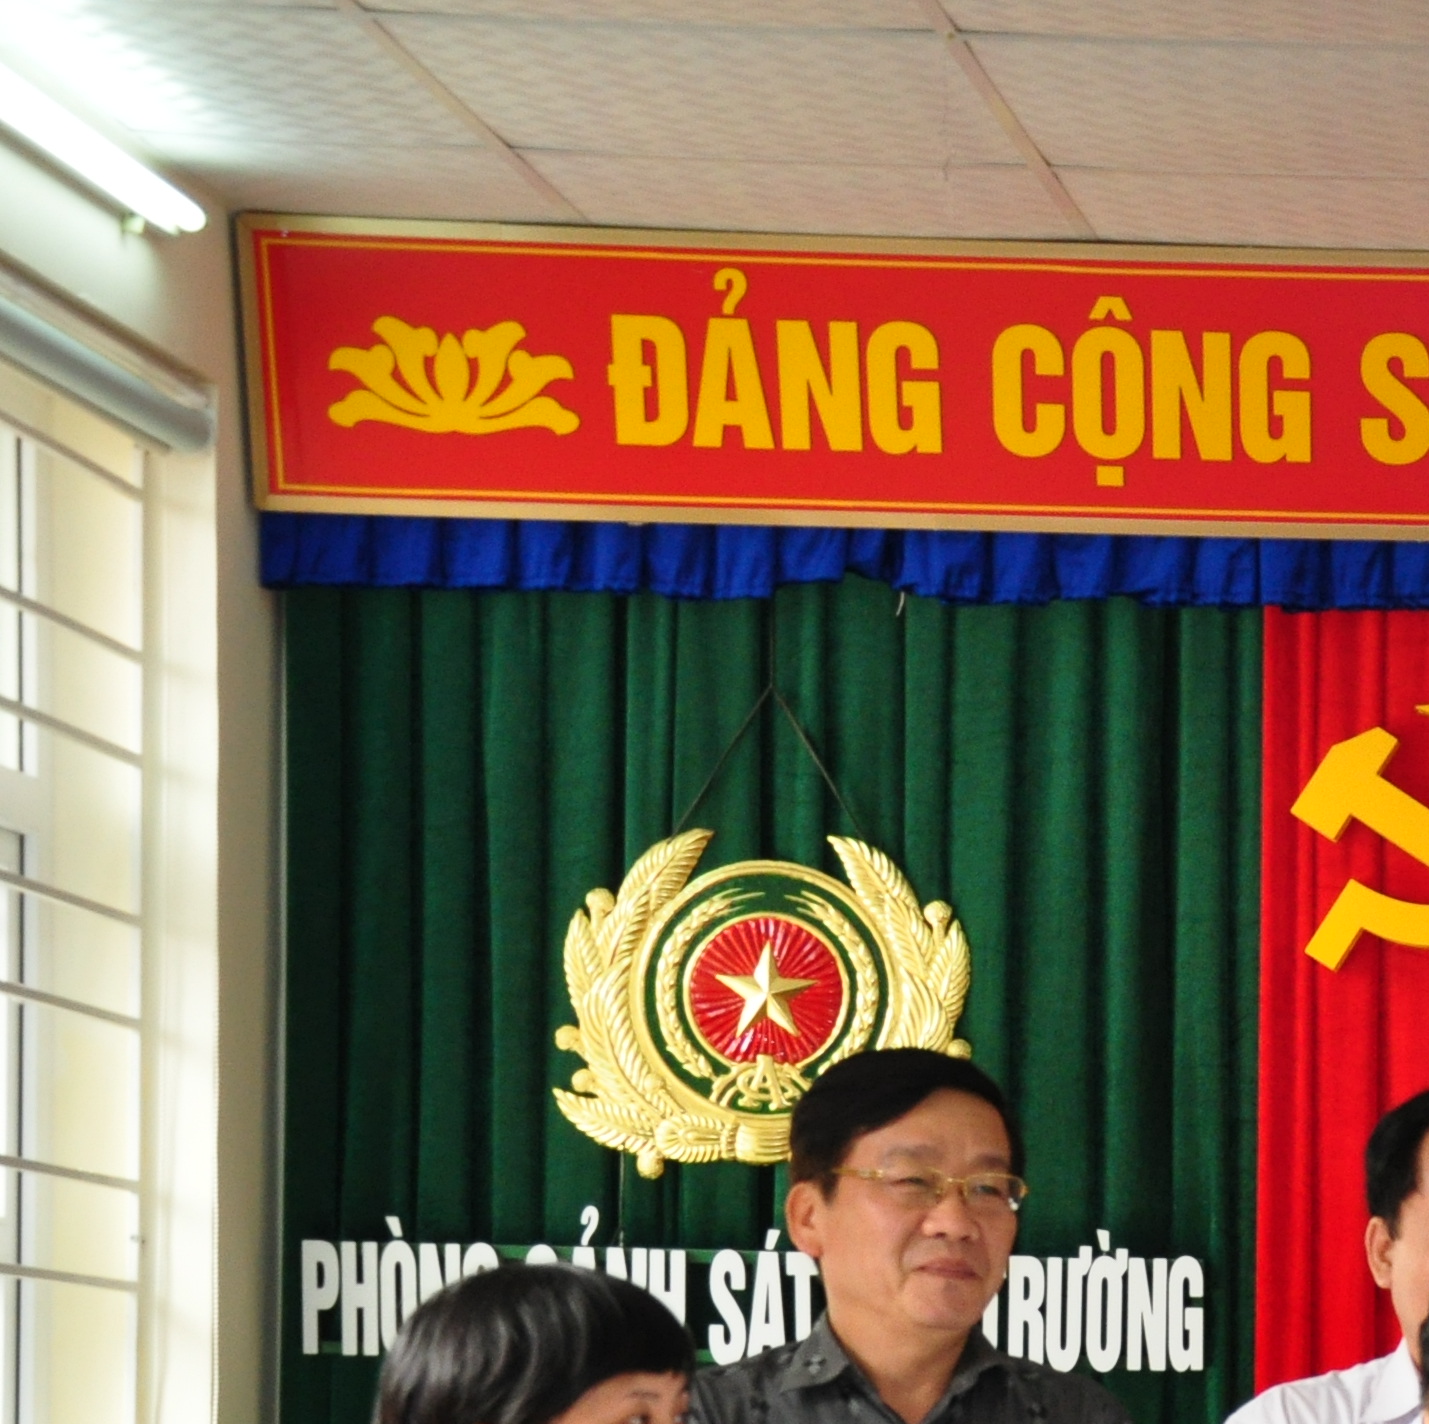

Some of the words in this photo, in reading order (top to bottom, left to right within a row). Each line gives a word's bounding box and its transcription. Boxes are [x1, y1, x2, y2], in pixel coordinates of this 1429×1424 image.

[608, 268, 942, 454] ĐẢNG
[992, 297, 1311, 486] CỘNG
[983, 1229, 1204, 1372] RƯỜNG
